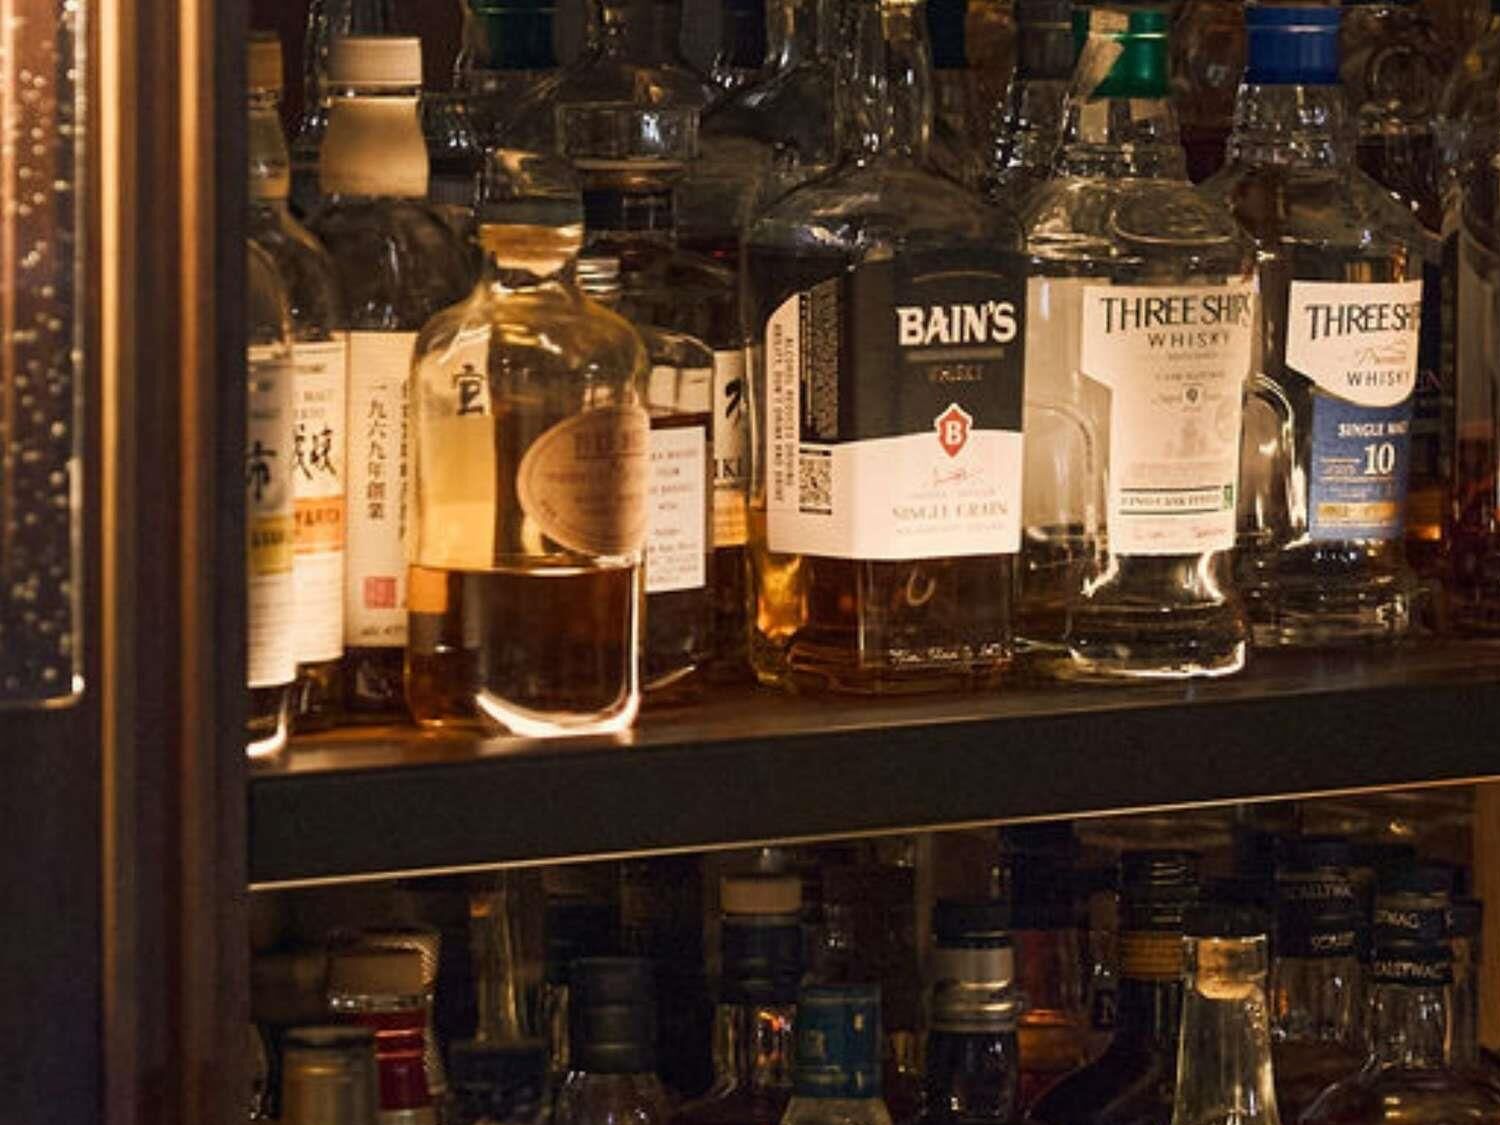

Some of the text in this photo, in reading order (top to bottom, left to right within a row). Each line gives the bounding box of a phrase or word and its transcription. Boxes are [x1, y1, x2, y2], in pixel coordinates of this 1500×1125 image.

[896, 300, 1017, 346] BAIN'S
[1100, 296, 1197, 333] THREE
[1306, 303, 1392, 340] THREE
[1148, 332, 1230, 348] WHISKY
[945, 420, 961, 446] B
[1364, 442, 1396, 475] 10
